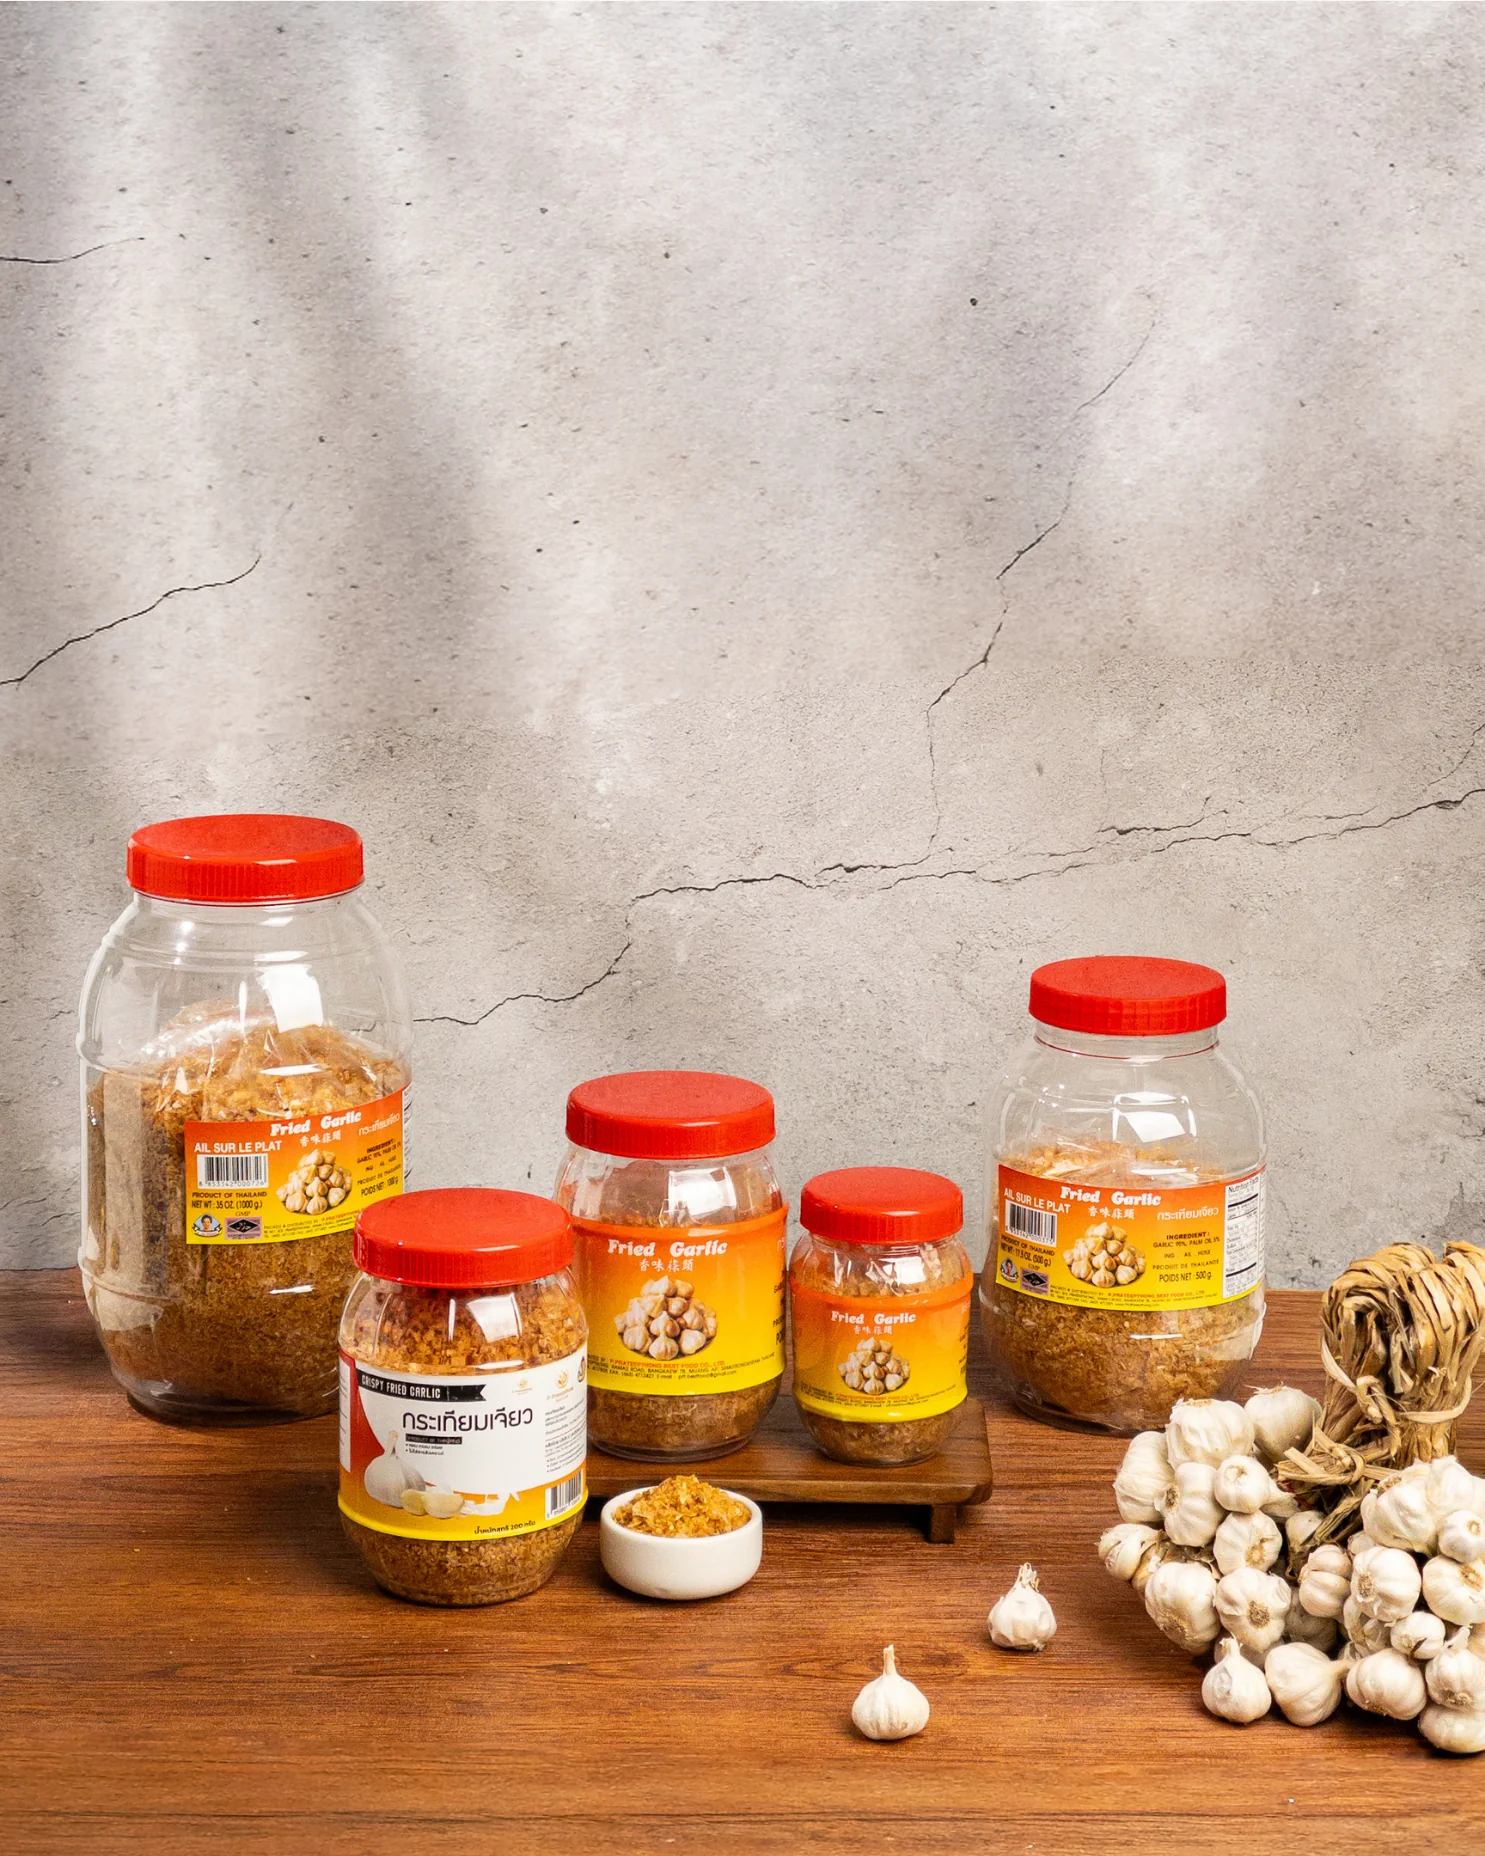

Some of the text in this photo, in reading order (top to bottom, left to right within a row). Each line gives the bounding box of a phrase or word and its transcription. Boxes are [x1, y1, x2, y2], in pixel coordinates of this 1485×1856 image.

[270, 1111, 362, 1137] Fried Garlic
[194, 1140, 282, 1153] AIL SUR LE PLAT
[192, 1200, 202, 1209] NET
[216, 1200, 224, 1209] 35
[1004, 1188, 1071, 1214] AIL SUR LE PLAT
[1060, 1186, 1162, 1206] Fried Garlic
[1157, 1206, 1219, 1221] กระเทียมเจียว
[608, 1239, 728, 1258] Fried Garlic
[1159, 1273, 1180, 1283] POIDS
[1196, 1271, 1206, 1280] 500
[831, 1310, 916, 1325] Fried Garlic
[361, 1375, 384, 1391] CRISPY
[386, 1382, 407, 1396] FRIED
[402, 1407, 533, 1432] กระเทียมเจียว
[510, 1523, 522, 1531] 200
